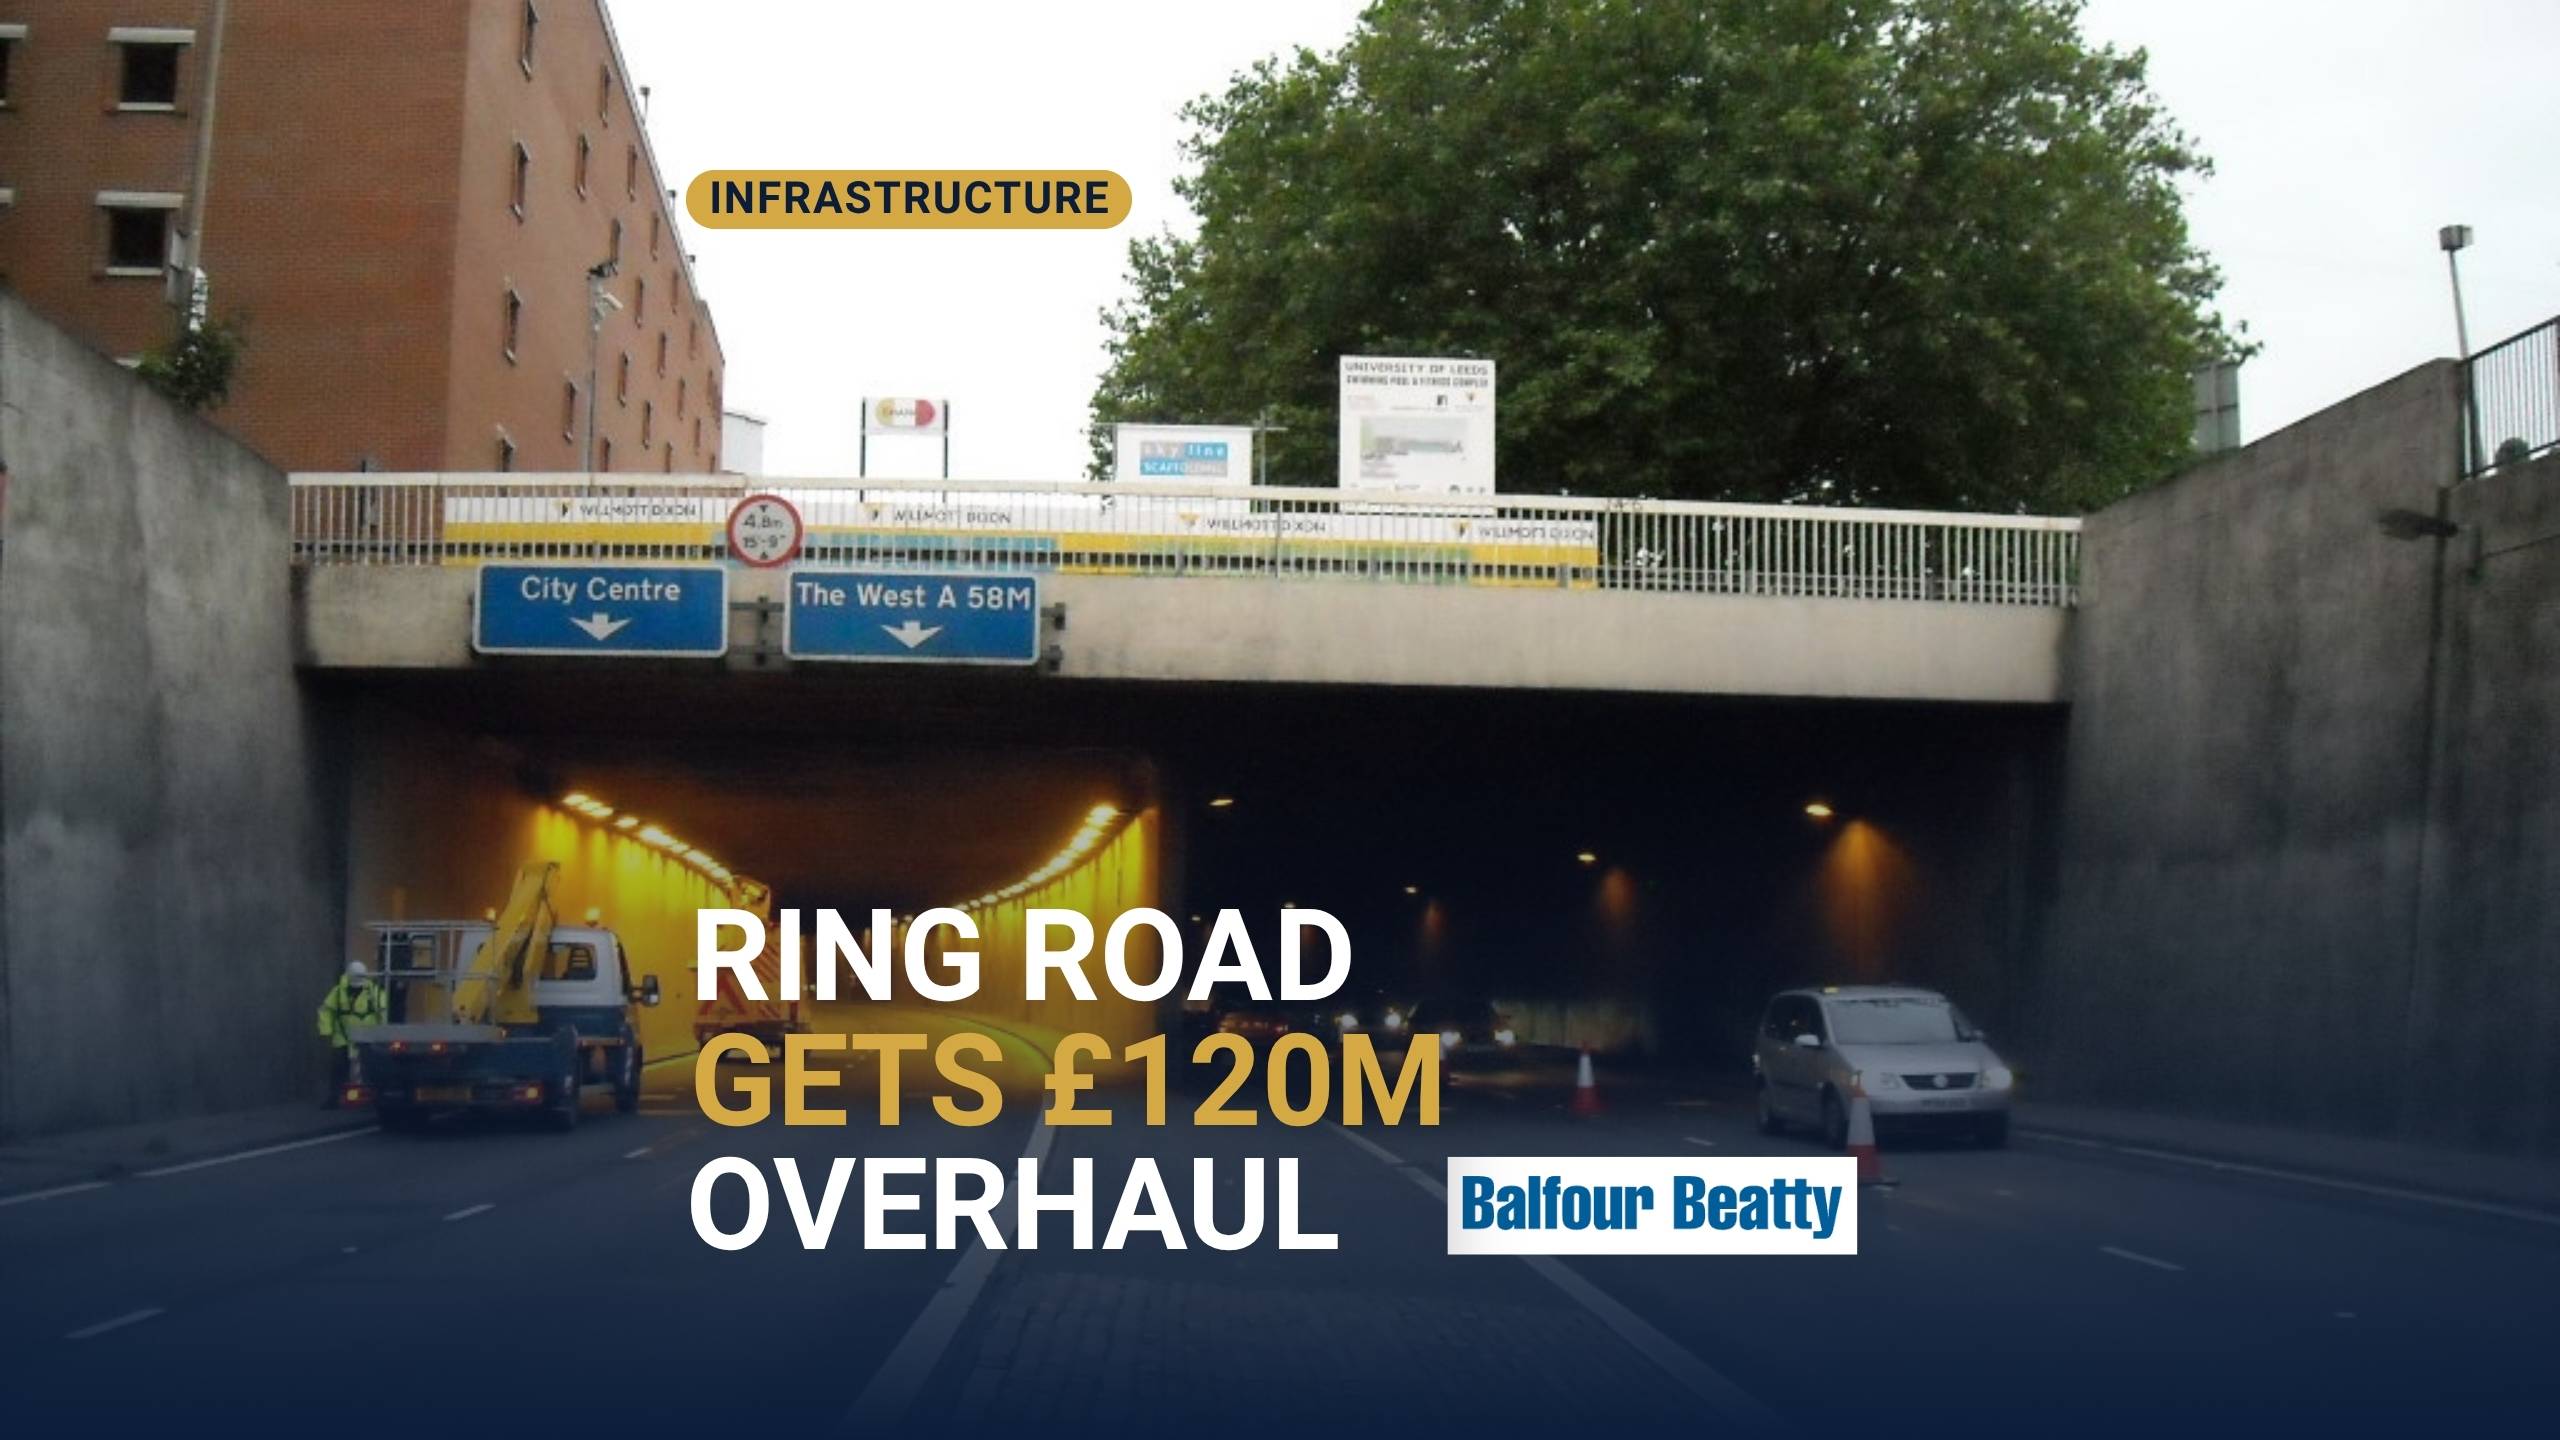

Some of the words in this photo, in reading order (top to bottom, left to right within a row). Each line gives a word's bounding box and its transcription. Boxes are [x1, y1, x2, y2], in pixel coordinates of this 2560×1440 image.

[1345, 362, 1423, 374] UNIVERSITY
[1430, 364, 1444, 374] OF
[1450, 364, 1488, 376] LEEDS
[1279, 520, 1327, 533] DXON
[521, 576, 577, 604] City
[586, 577, 681, 601] Centre
[796, 582, 846, 606] The
[857, 584, 926, 608] West
[937, 586, 957, 608] A
[967, 586, 1031, 610] 58M
